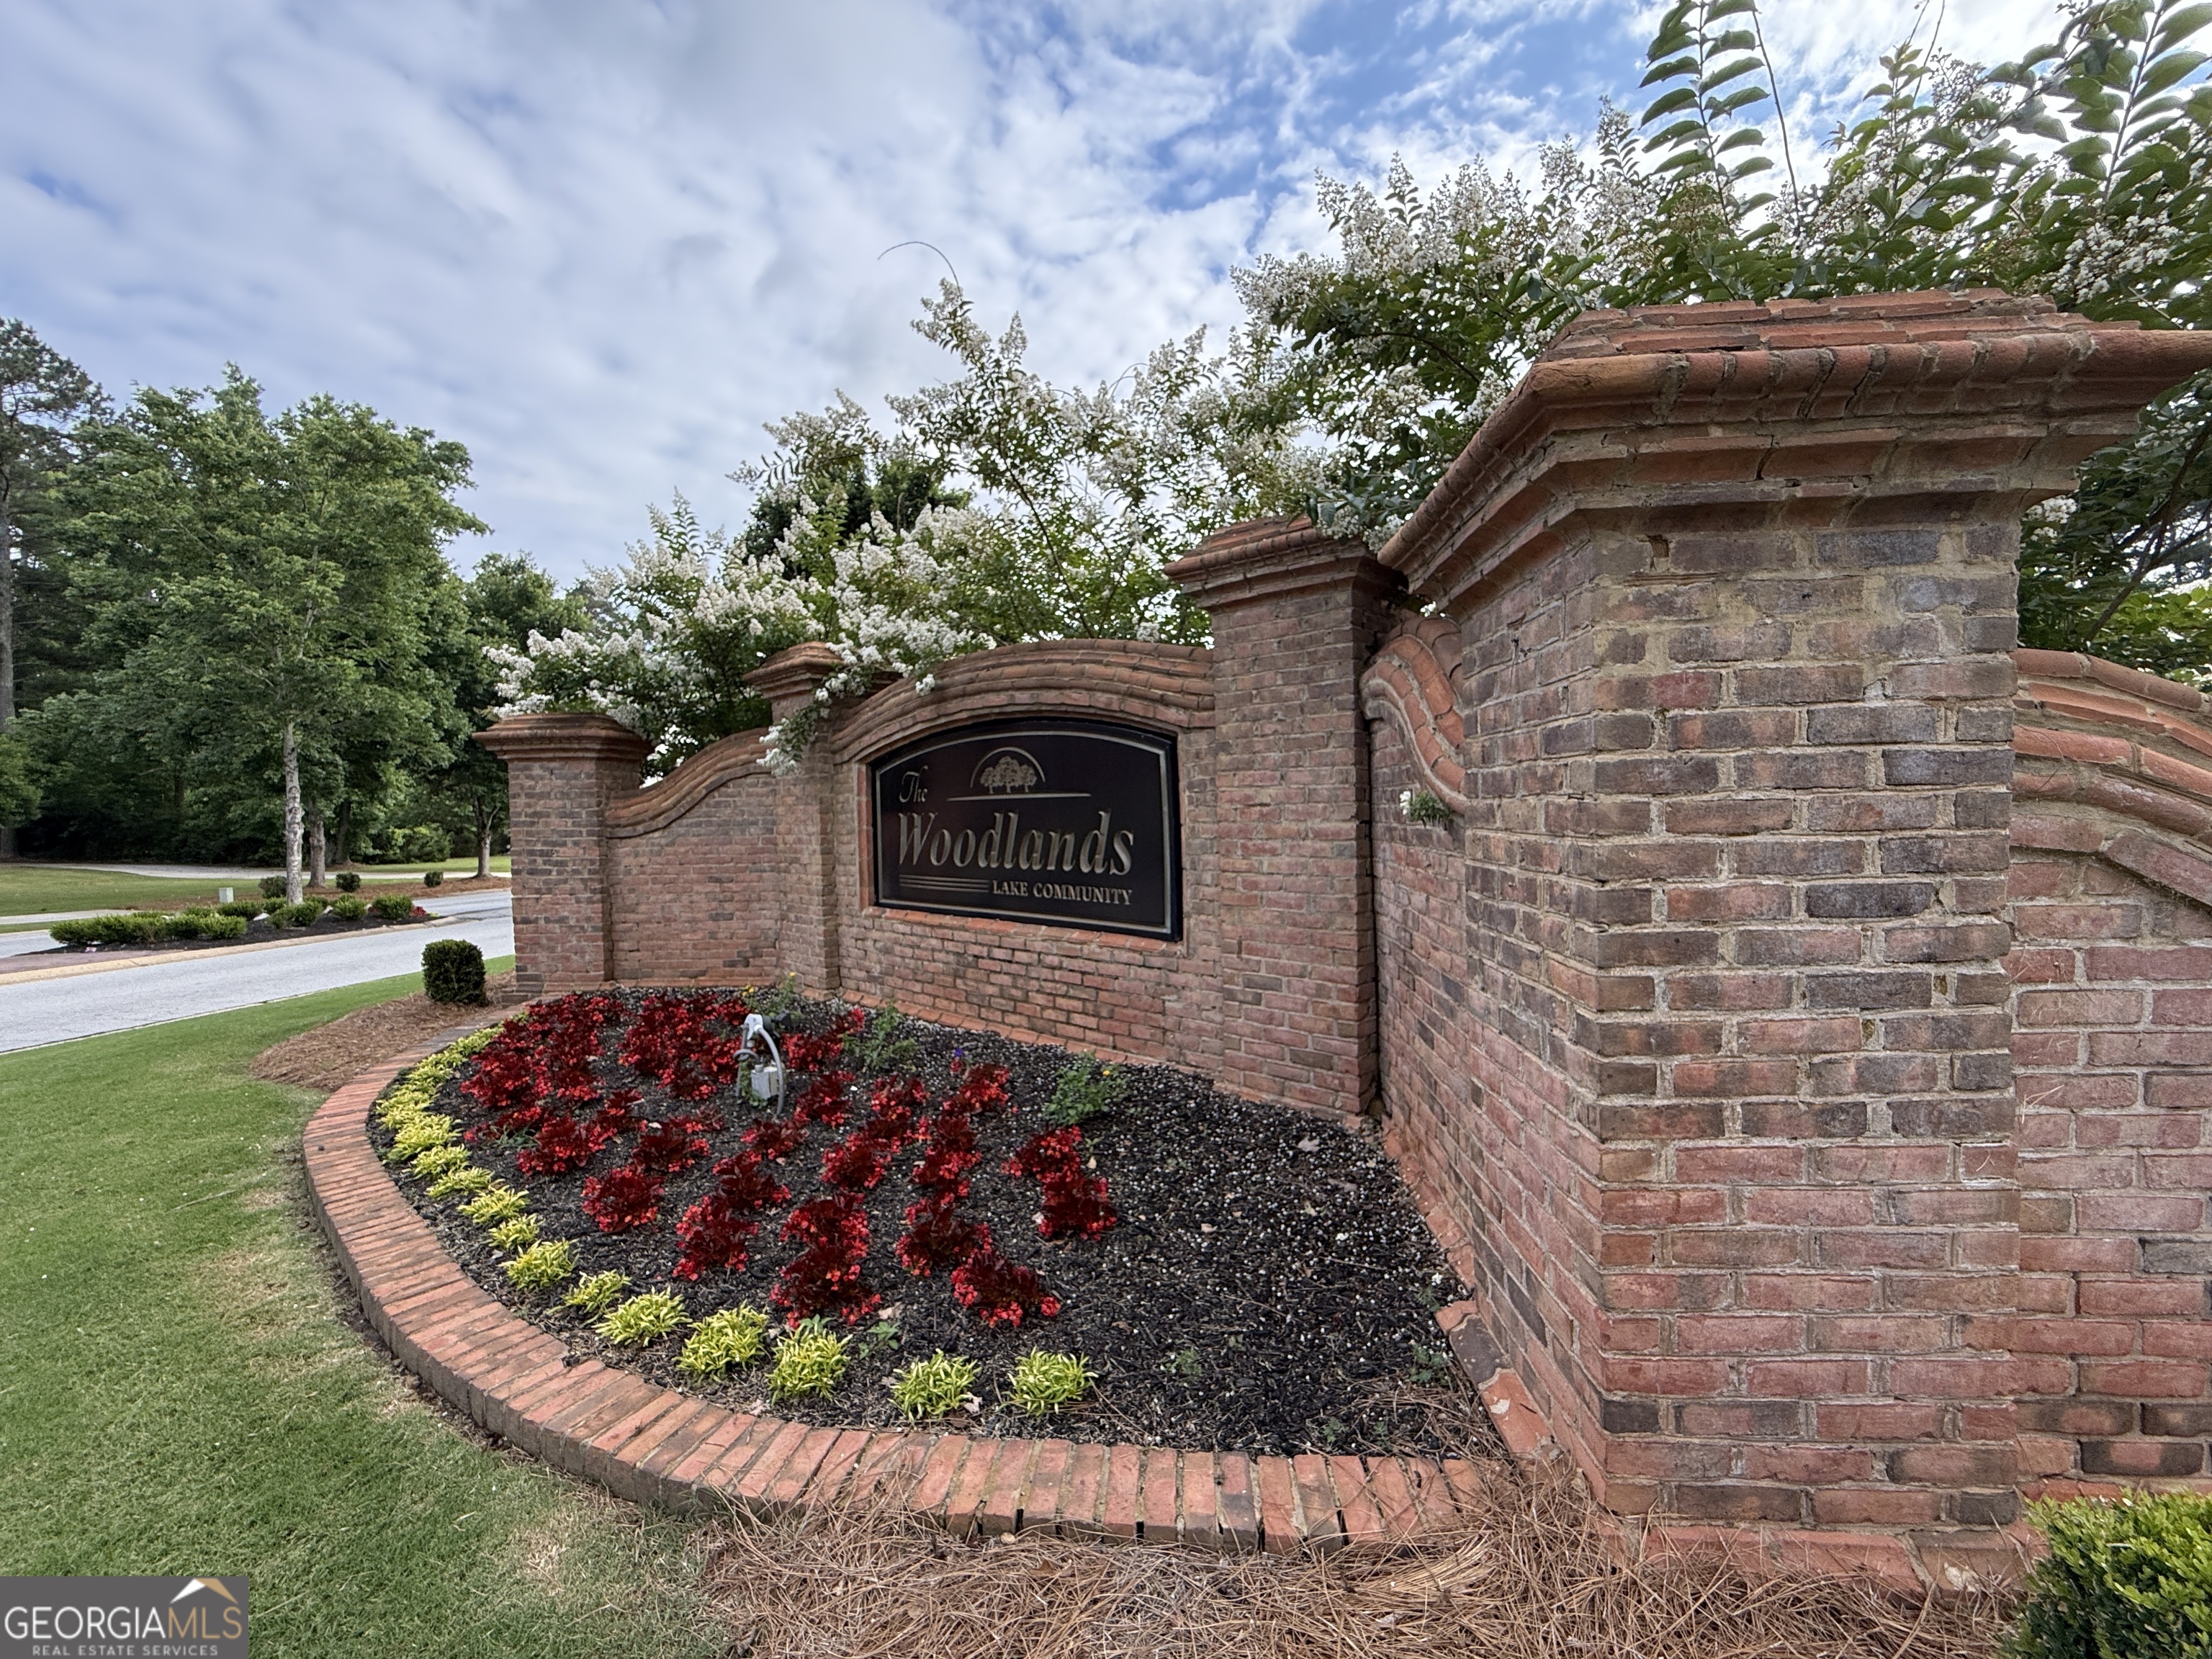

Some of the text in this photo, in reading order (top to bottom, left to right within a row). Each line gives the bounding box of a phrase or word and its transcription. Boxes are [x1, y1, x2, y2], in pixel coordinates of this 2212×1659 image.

[899, 765, 929, 804] The
[897, 809, 1135, 876] Woodlands
[992, 879, 1133, 906] LAKE COMMUNITY
